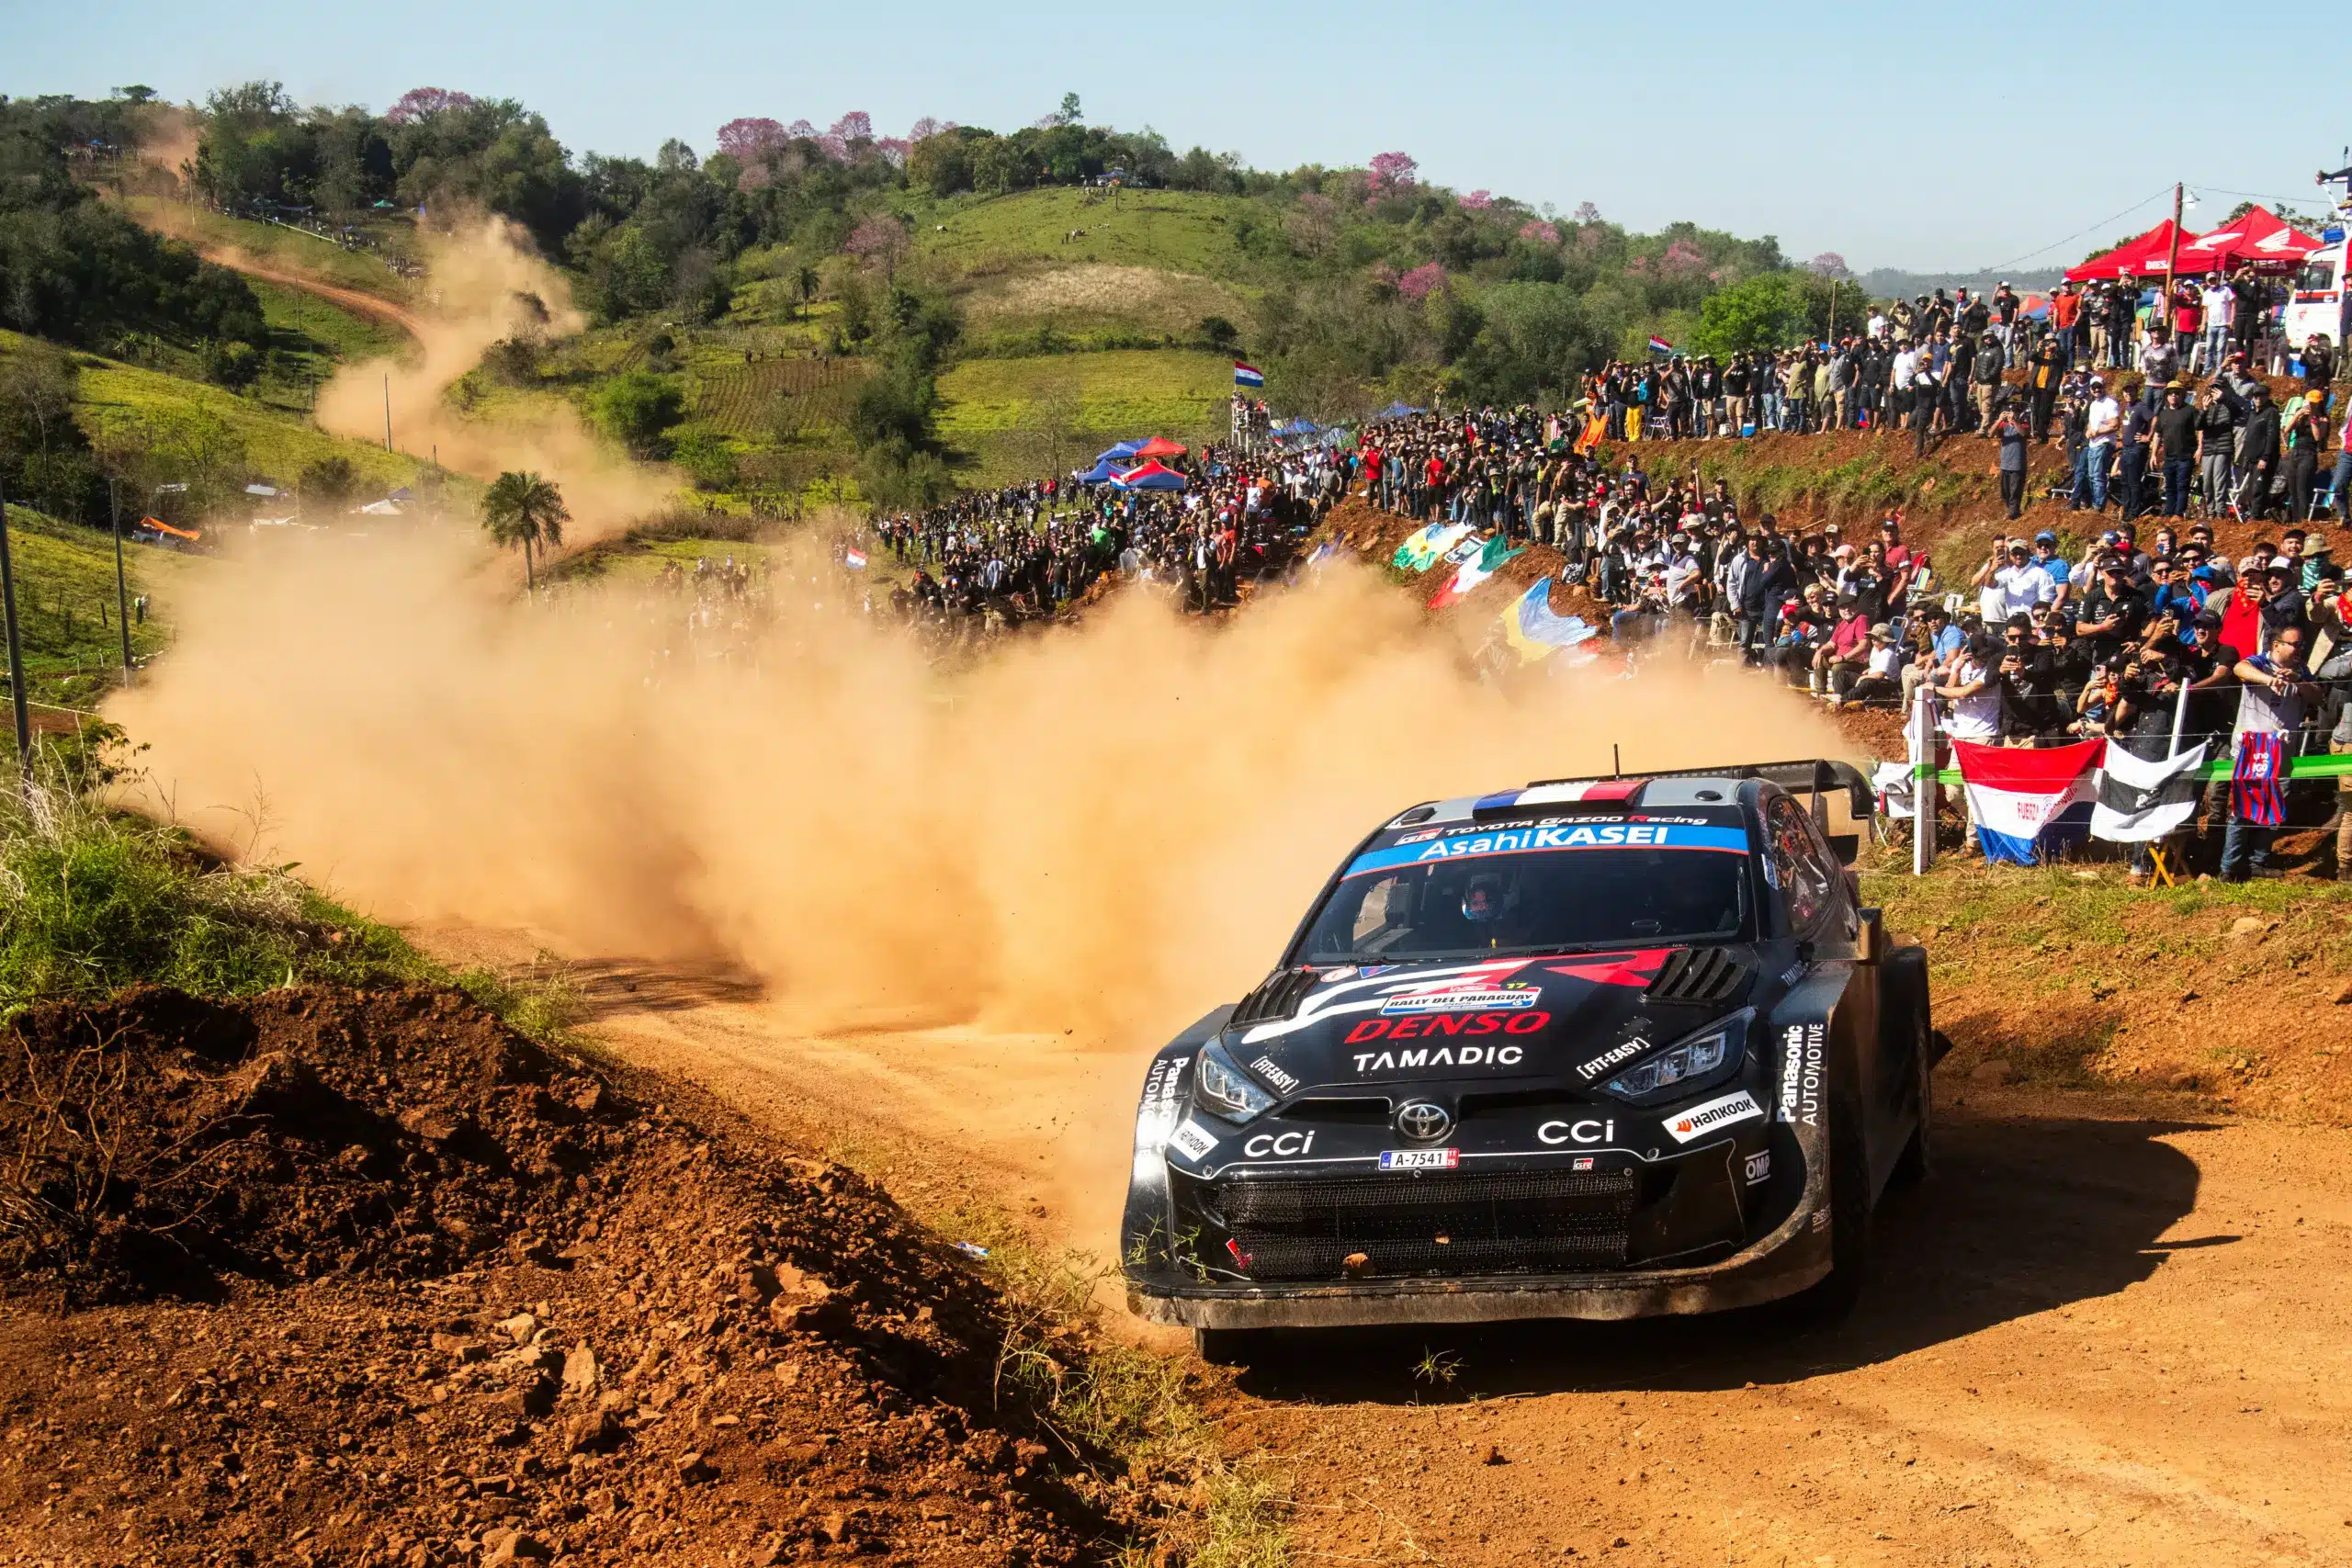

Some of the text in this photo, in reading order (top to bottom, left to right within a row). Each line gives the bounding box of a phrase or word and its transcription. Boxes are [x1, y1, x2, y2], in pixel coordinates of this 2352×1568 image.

[1445, 819, 1535, 836] TOYOTA
[1540, 816, 1623, 828] GAZOO
[1627, 814, 1708, 826] Racing
[1389, 998, 1430, 1007] RALLY
[1458, 994, 1533, 1002] PARAGUAY
[1344, 1011, 1551, 1043] DENSO
[1352, 1046, 1523, 1072] TAMADIC
[1777, 1025, 1804, 1122] Panasonic
[1802, 1023, 1824, 1126] AUTOMOTIVE
[1395, 1153, 1442, 1166] A-7541
[1746, 1155, 1770, 1179] OMP
